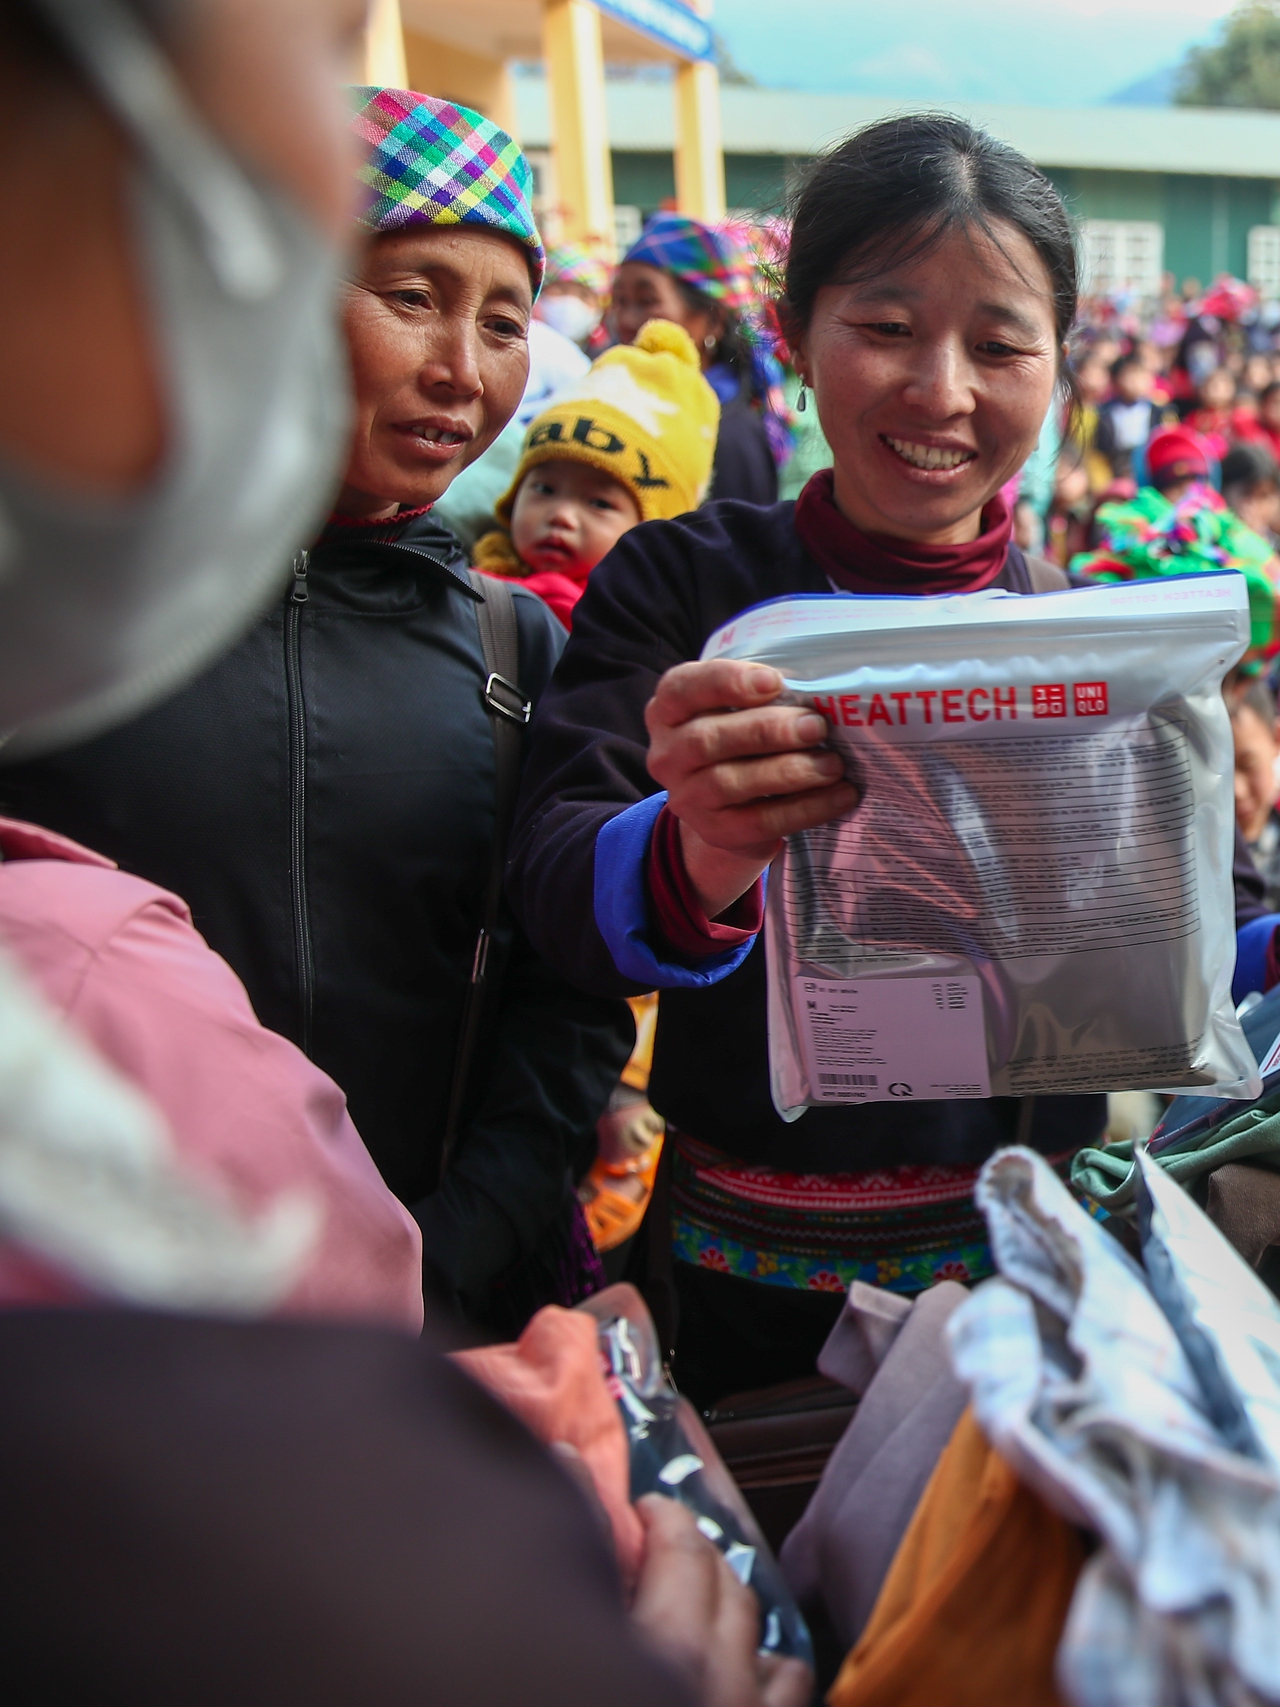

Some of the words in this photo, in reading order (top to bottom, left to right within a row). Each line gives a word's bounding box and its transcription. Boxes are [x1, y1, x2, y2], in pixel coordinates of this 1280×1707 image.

[1076, 686, 1102, 698] UNI
[813, 686, 1018, 727] HEATTECH
[1077, 700, 1105, 713] QLO
